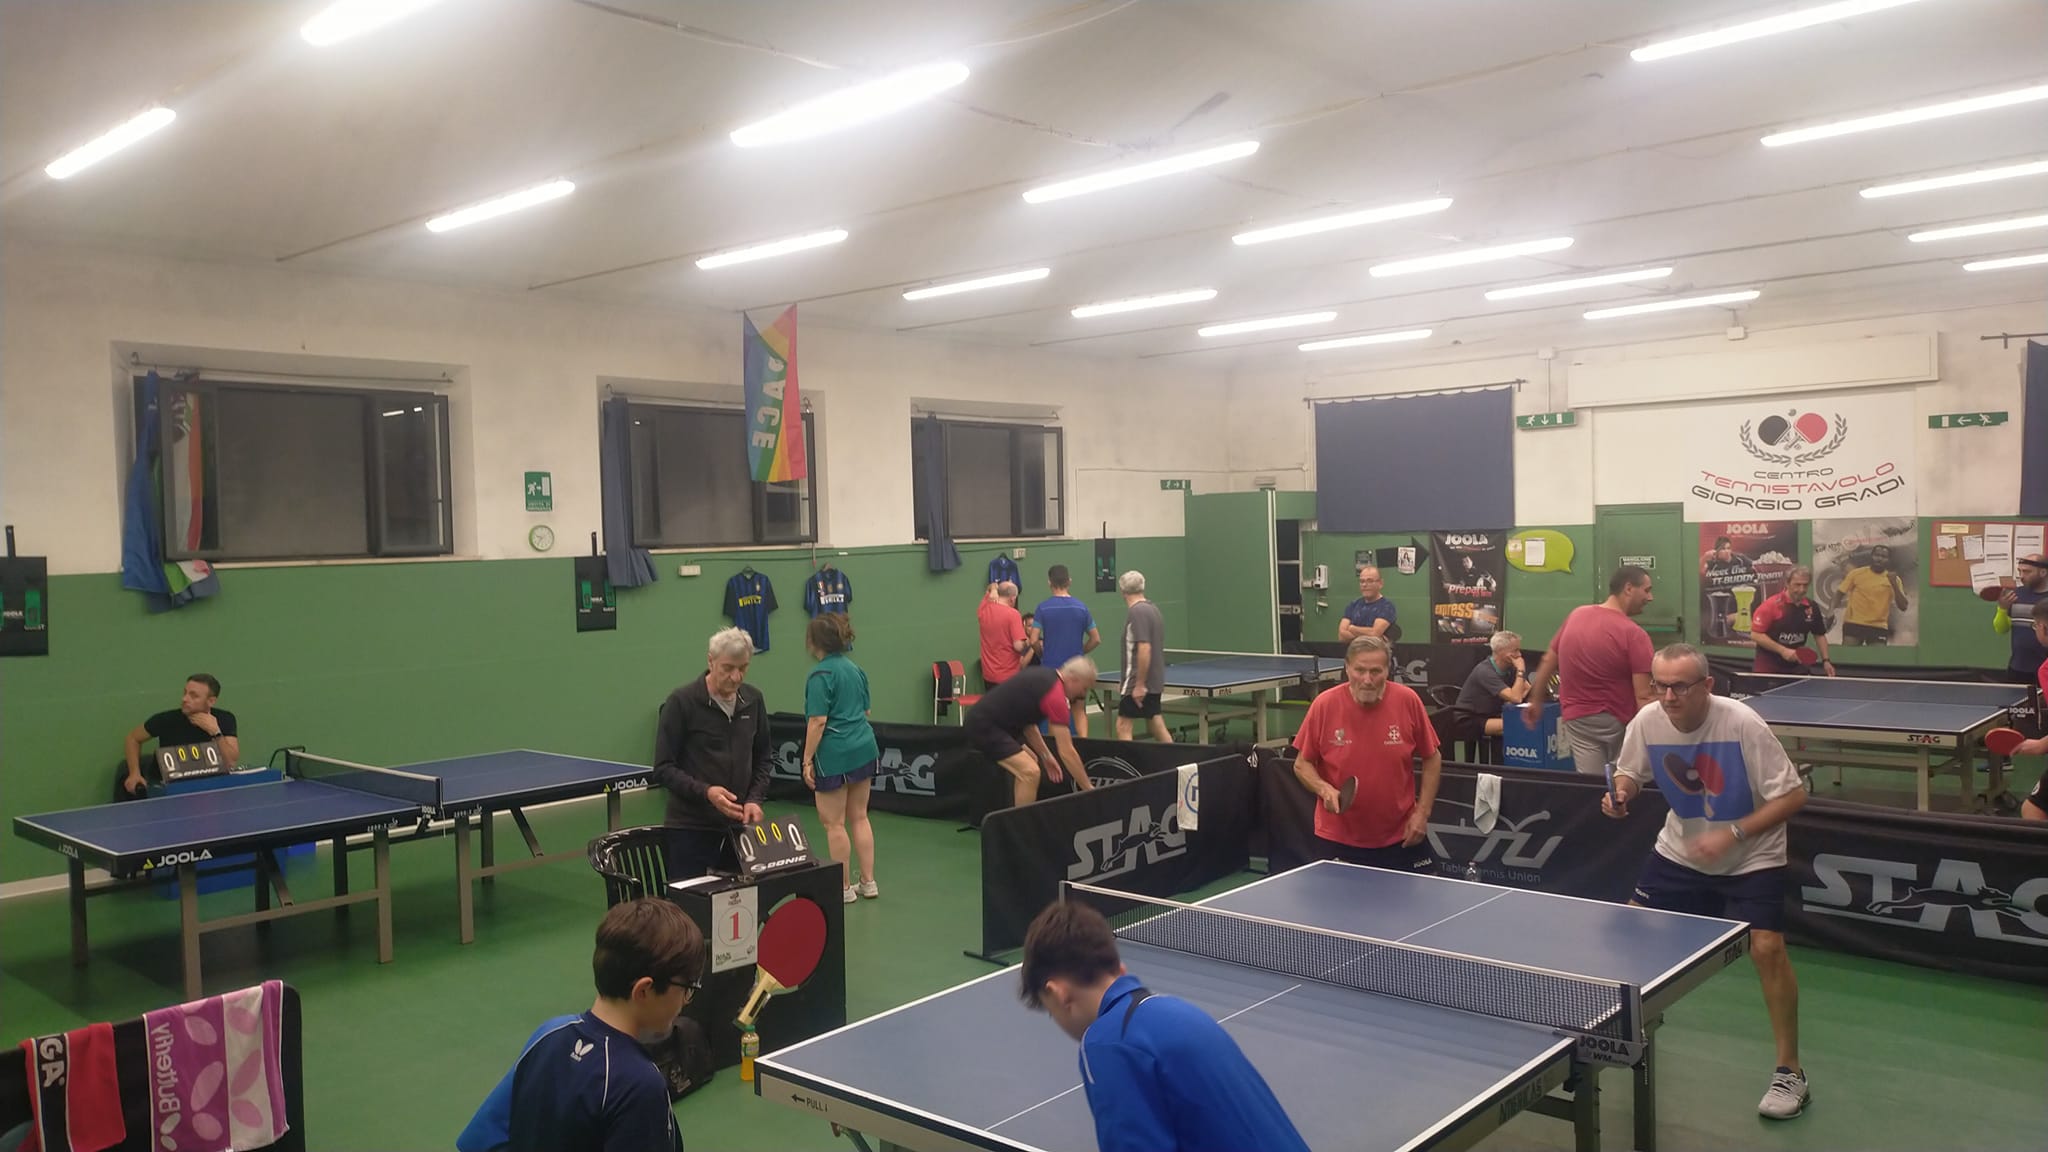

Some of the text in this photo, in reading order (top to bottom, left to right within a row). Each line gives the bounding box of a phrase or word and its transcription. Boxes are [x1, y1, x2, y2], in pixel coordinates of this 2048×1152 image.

[1701, 462, 1895, 495] TENNISTAVOLO
[1754, 468, 1834, 479] CENTRO
[1691, 475, 1905, 511] GIORGIO GRADI
[1727, 523, 1769, 535] JOOLA
[1445, 534, 1489, 546] JOOLA
[1907, 734, 1940, 744] STAG
[1506, 746, 1538, 758] JOOLA
[612, 777, 649, 792] JOOLA
[157, 848, 213, 868] JOOLA
[767, 855, 807, 869] DONIC
[1507, 871, 1541, 884] Union
[730, 912, 742, 940] 1
[1578, 1034, 1630, 1057] JOOLA
[806, 1097, 824, 1112] PULL
